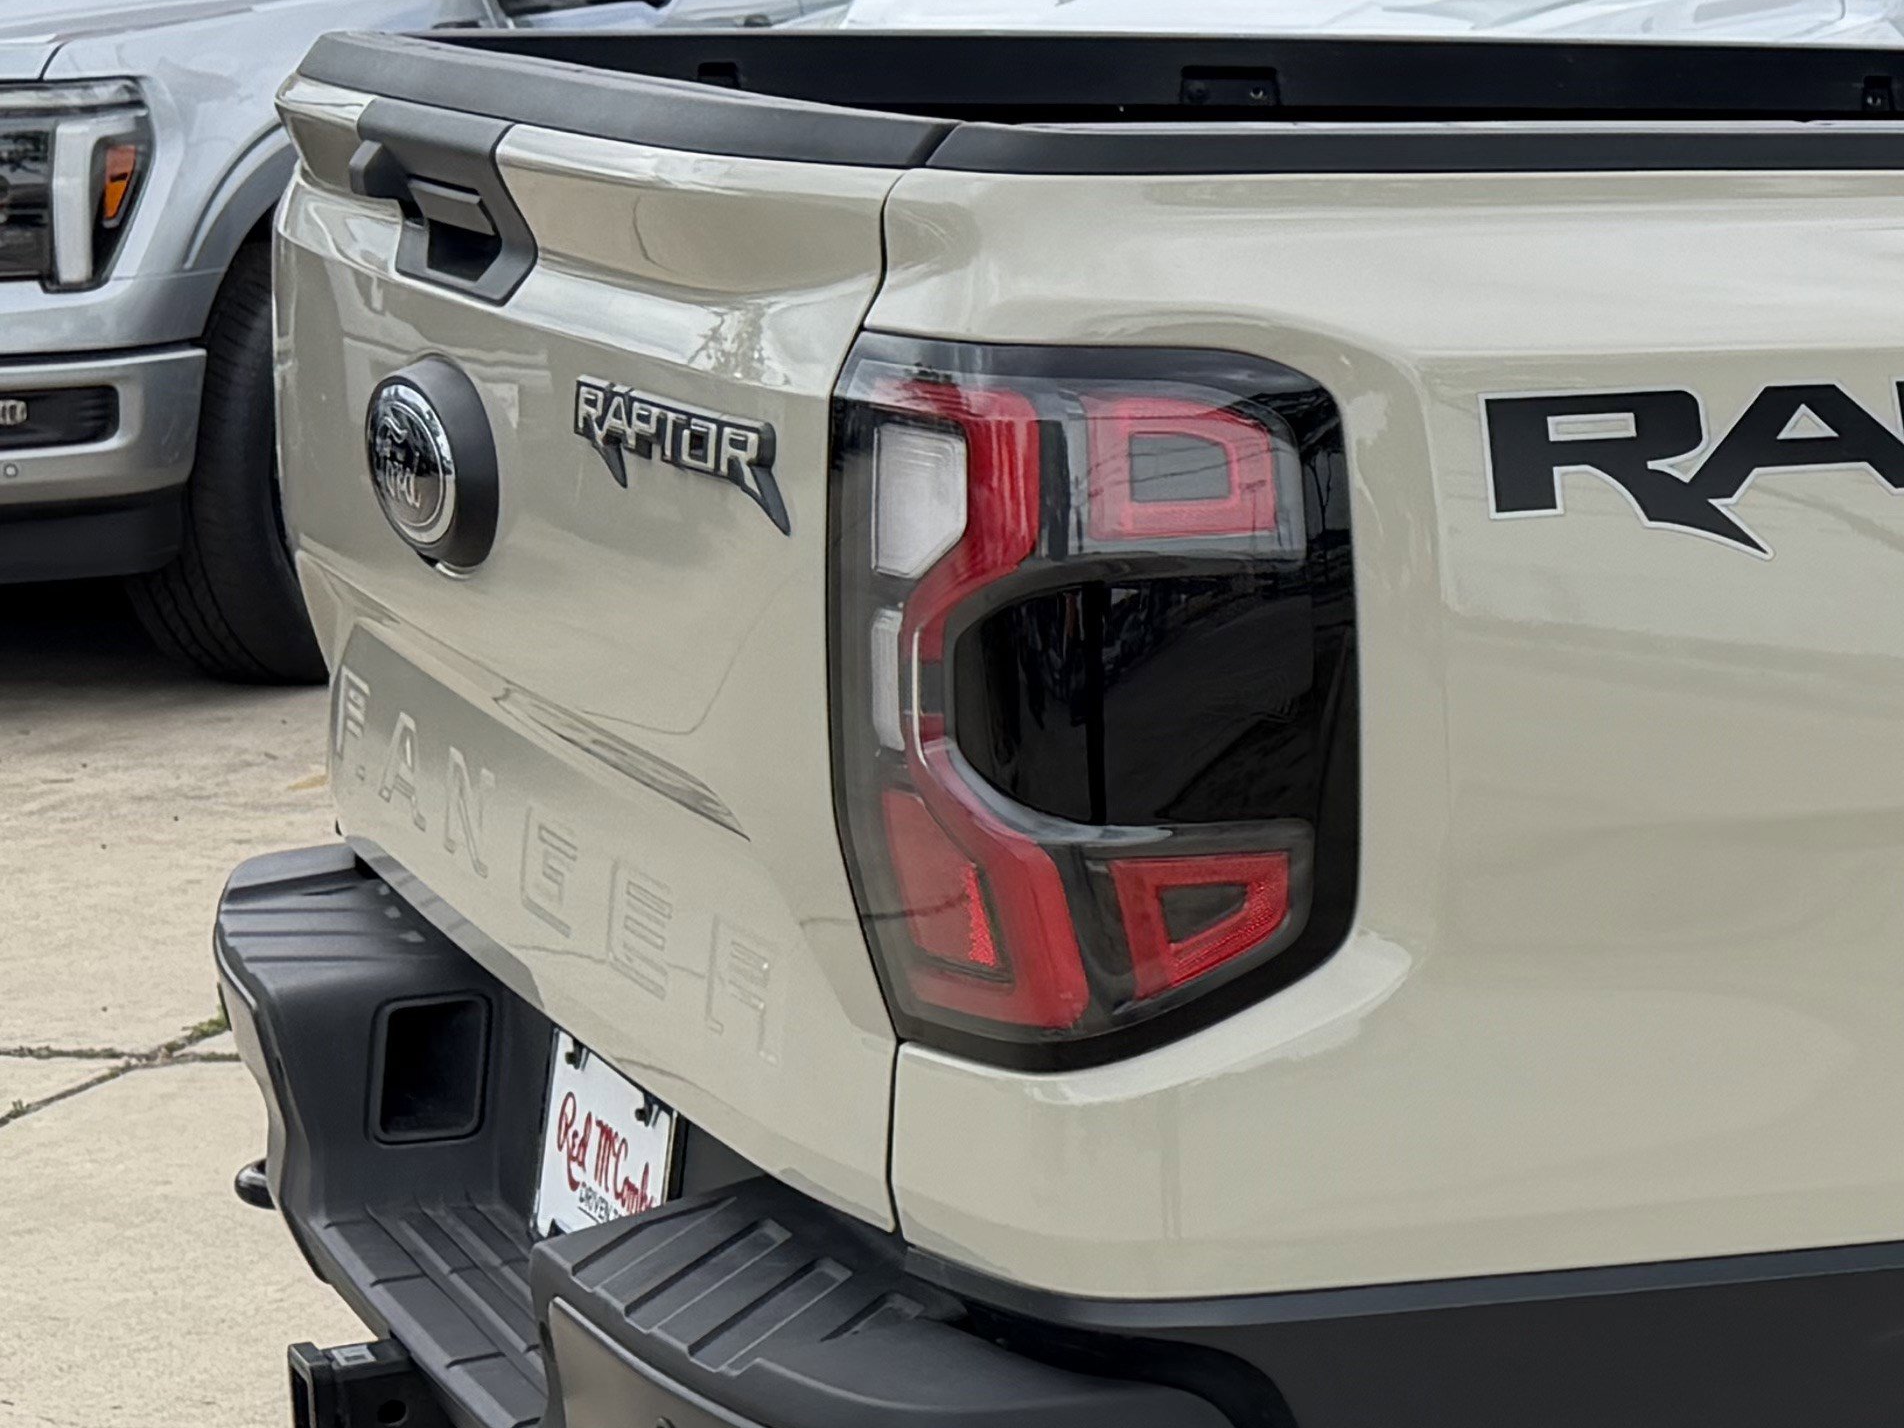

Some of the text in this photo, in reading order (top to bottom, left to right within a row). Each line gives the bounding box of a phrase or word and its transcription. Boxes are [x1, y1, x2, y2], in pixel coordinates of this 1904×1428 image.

[575, 374, 791, 537] RAPTOR
[334, 664, 780, 1067] RANGER
[556, 1090, 593, 1193] Red
